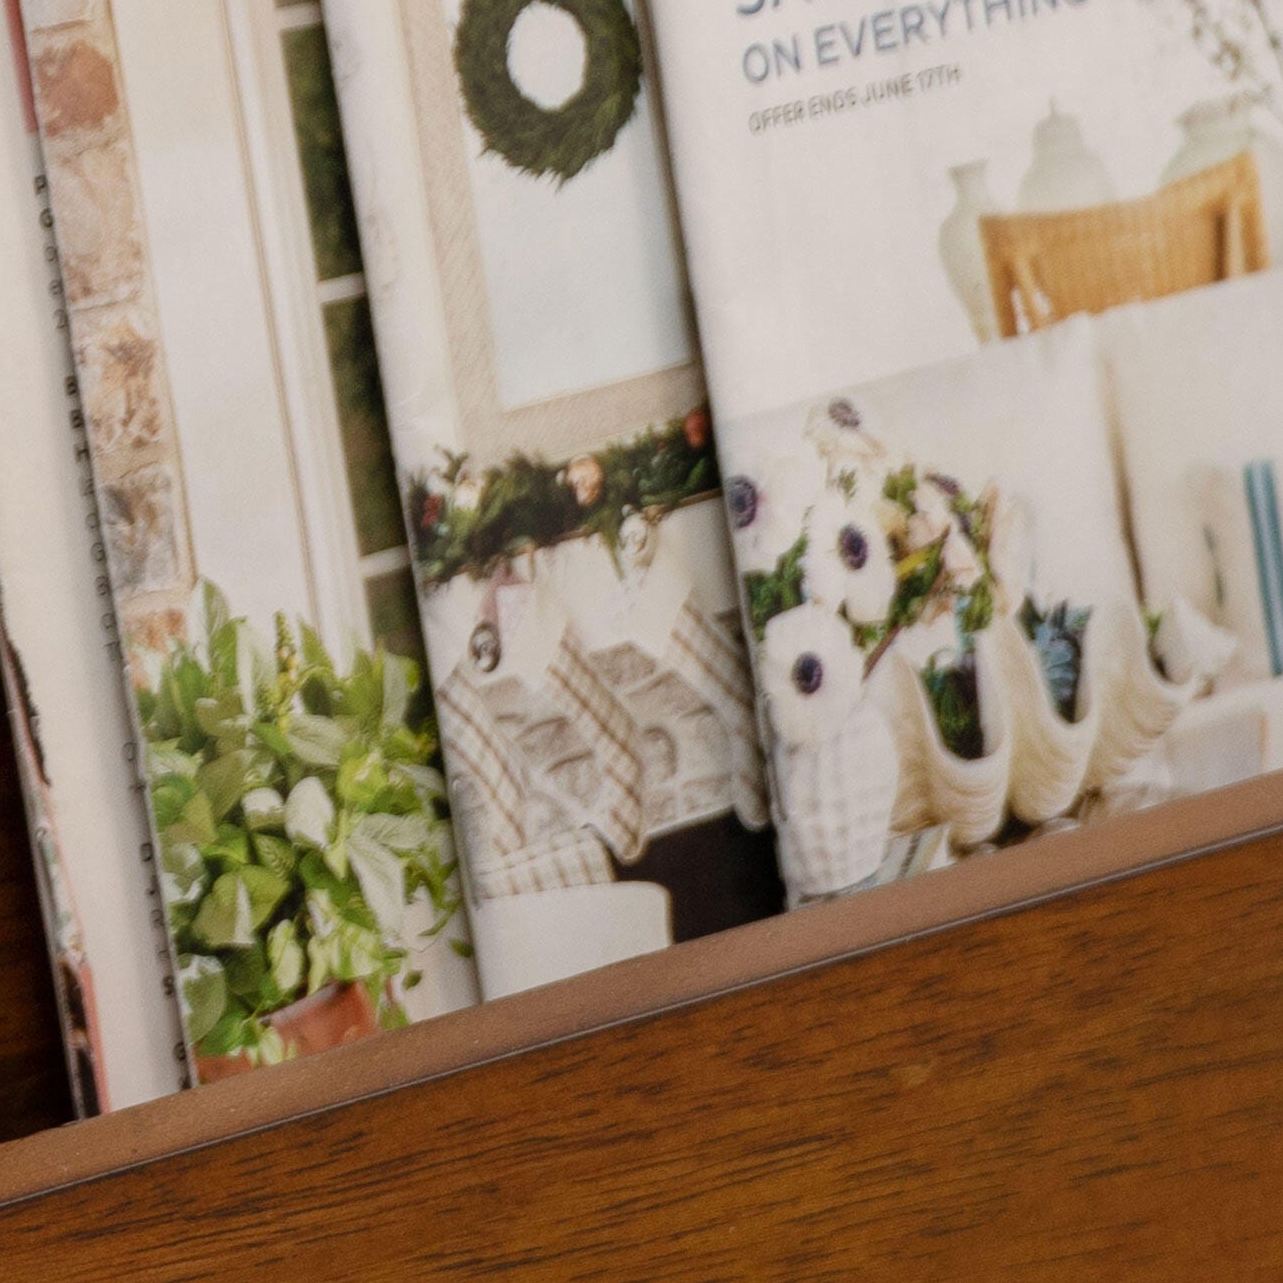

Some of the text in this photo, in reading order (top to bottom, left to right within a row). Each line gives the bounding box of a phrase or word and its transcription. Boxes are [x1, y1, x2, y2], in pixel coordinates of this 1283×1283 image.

[742, 34, 801, 85] ON
[748, 101, 807, 135] OFFER
[808, 86, 858, 118] ENDS
[863, 71, 914, 106] JUNE
